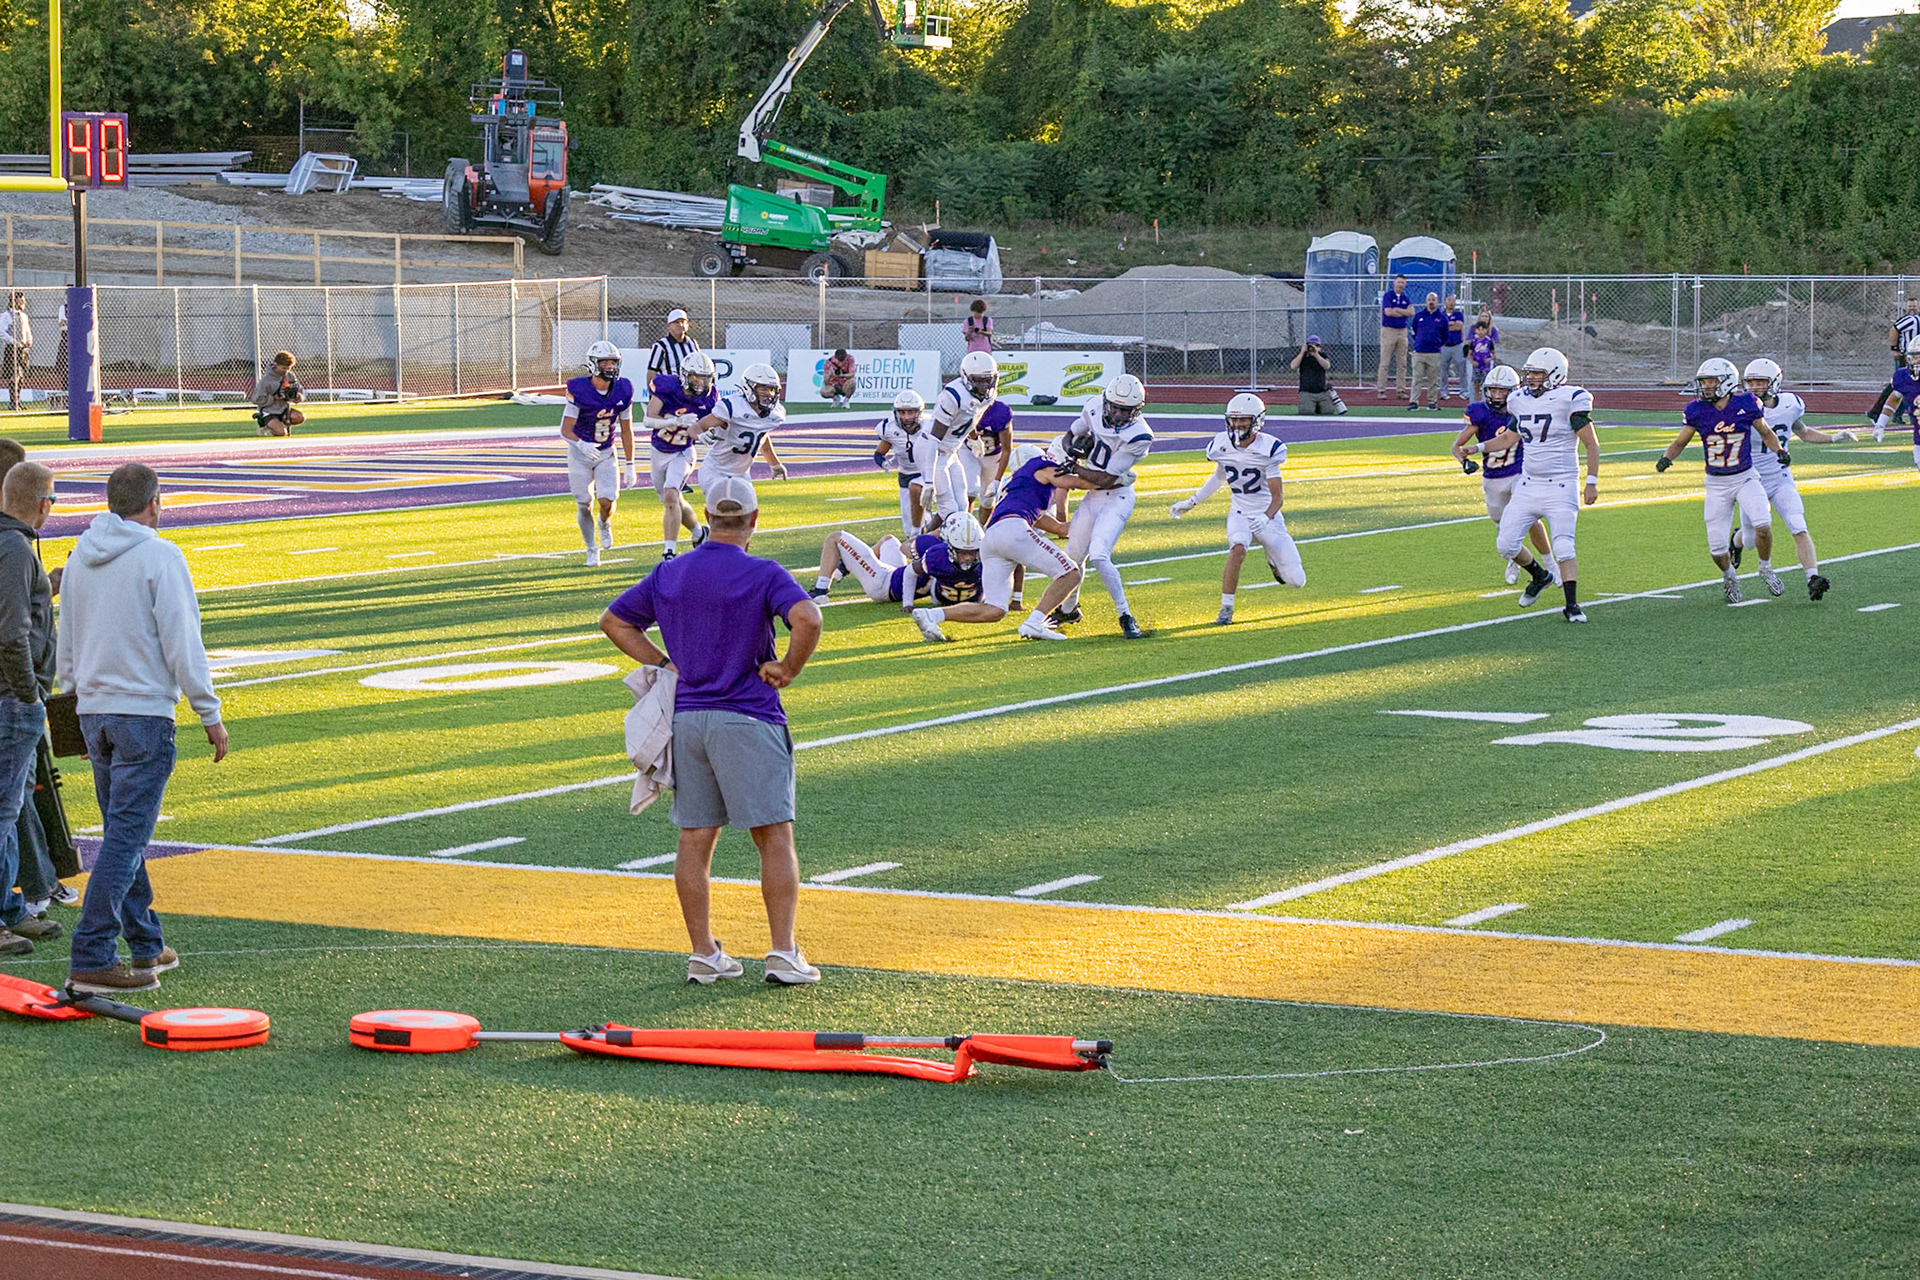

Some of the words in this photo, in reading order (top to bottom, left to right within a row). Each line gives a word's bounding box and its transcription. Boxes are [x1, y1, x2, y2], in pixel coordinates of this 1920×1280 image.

[67, 119, 124, 181] 40
[854, 363, 871, 374] THE
[872, 358, 915, 374] DERM
[855, 376, 913, 390] NSTITUTE
[862, 391, 880, 399] WEST
[881, 391, 900, 399] MICH
[594, 419, 611, 443] 8
[1518, 414, 1553, 443] 57
[1714, 421, 1735, 433] Cal
[1091, 439, 1112, 470] 0
[1706, 432, 1746, 467] 27
[1224, 465, 1262, 495] 22
[859, 560, 877, 578] SCOTS
[1053, 552, 1072, 571] SCOTS
